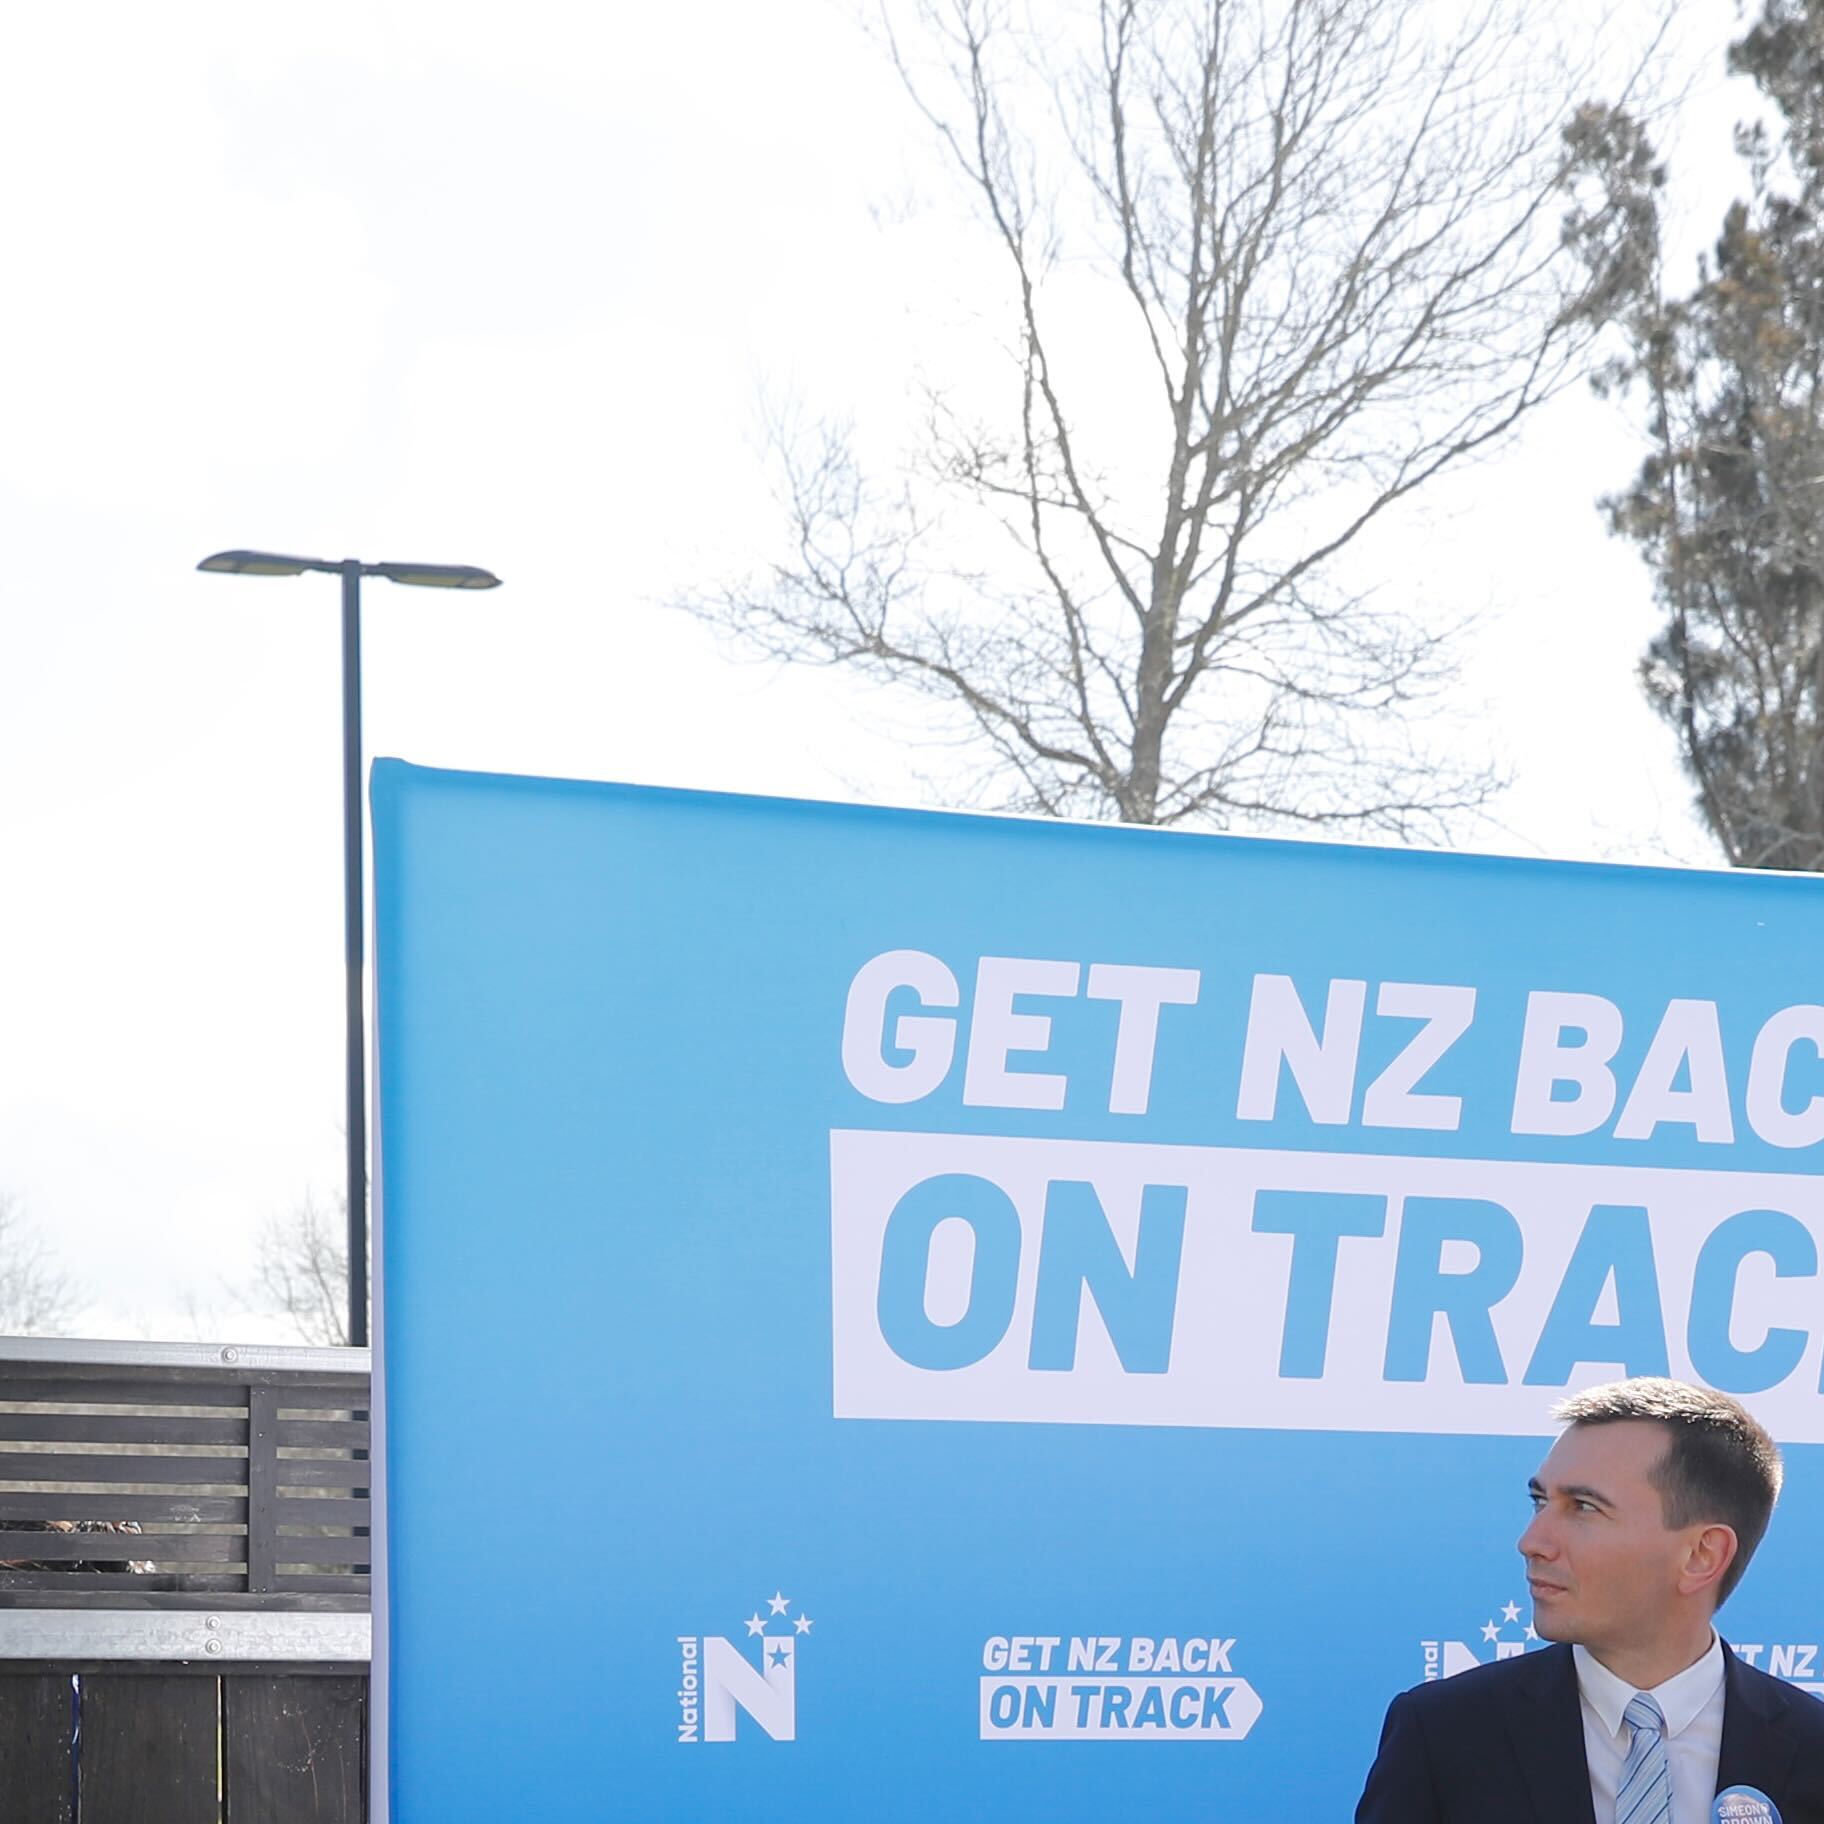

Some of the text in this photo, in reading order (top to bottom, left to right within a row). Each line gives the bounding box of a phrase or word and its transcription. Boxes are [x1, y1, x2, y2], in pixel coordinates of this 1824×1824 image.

[842, 949, 1201, 1115] GET
[1236, 973, 1476, 1131] NZ
[877, 1173, 1188, 1375] ON
[677, 1637, 697, 1743] National
[982, 1636, 1236, 1673] GET NZ BACK
[1769, 1644, 1818, 1677] NZ
[989, 1685, 1236, 1729] ON TRACK
